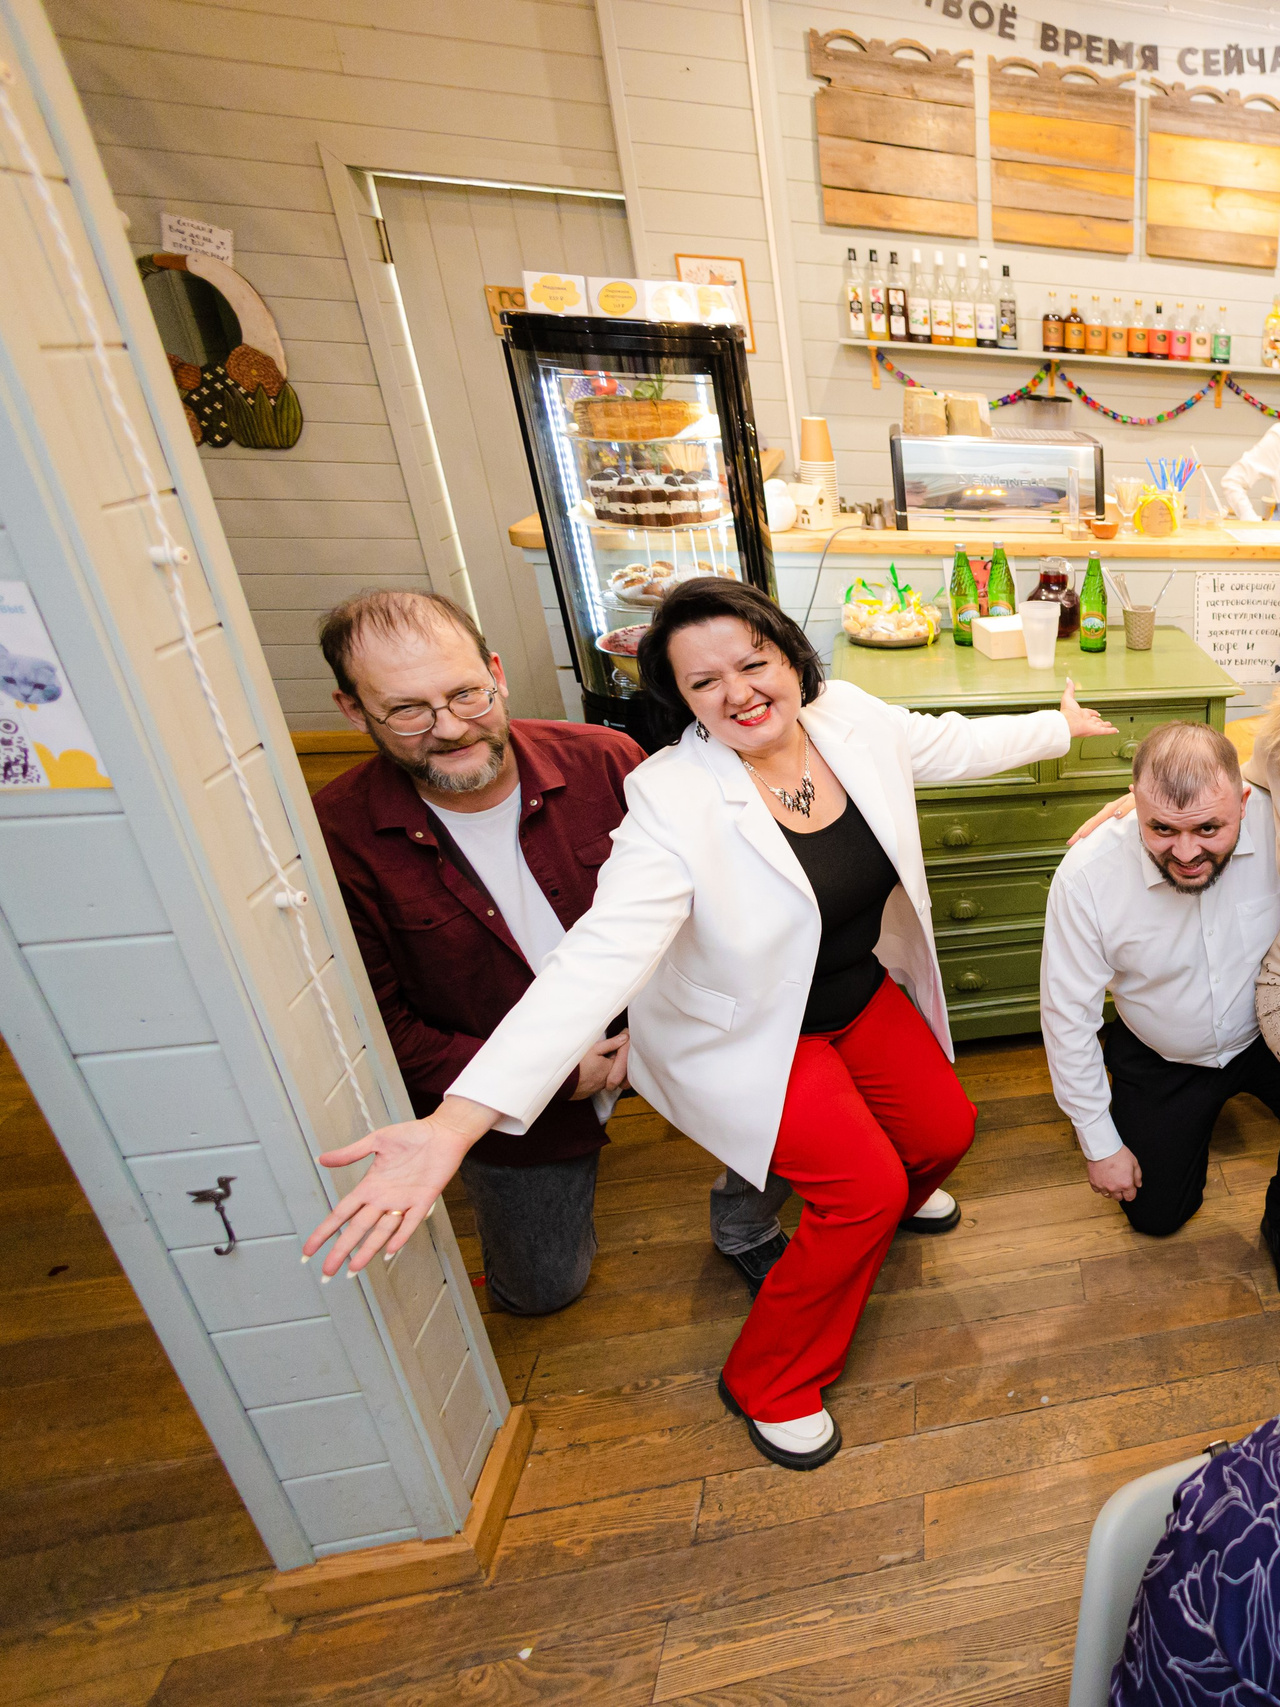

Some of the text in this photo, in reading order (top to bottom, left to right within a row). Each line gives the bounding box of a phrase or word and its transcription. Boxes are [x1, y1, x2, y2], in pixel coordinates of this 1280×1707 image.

[925, 0, 1018, 40] ВОЁ
[1040, 21, 1159, 72] ВРЕМЯ
[1212, 578, 1276, 593] Не совершай
[1207, 628, 1247, 638] захвати
[1233, 658, 1277, 667] выпечку
